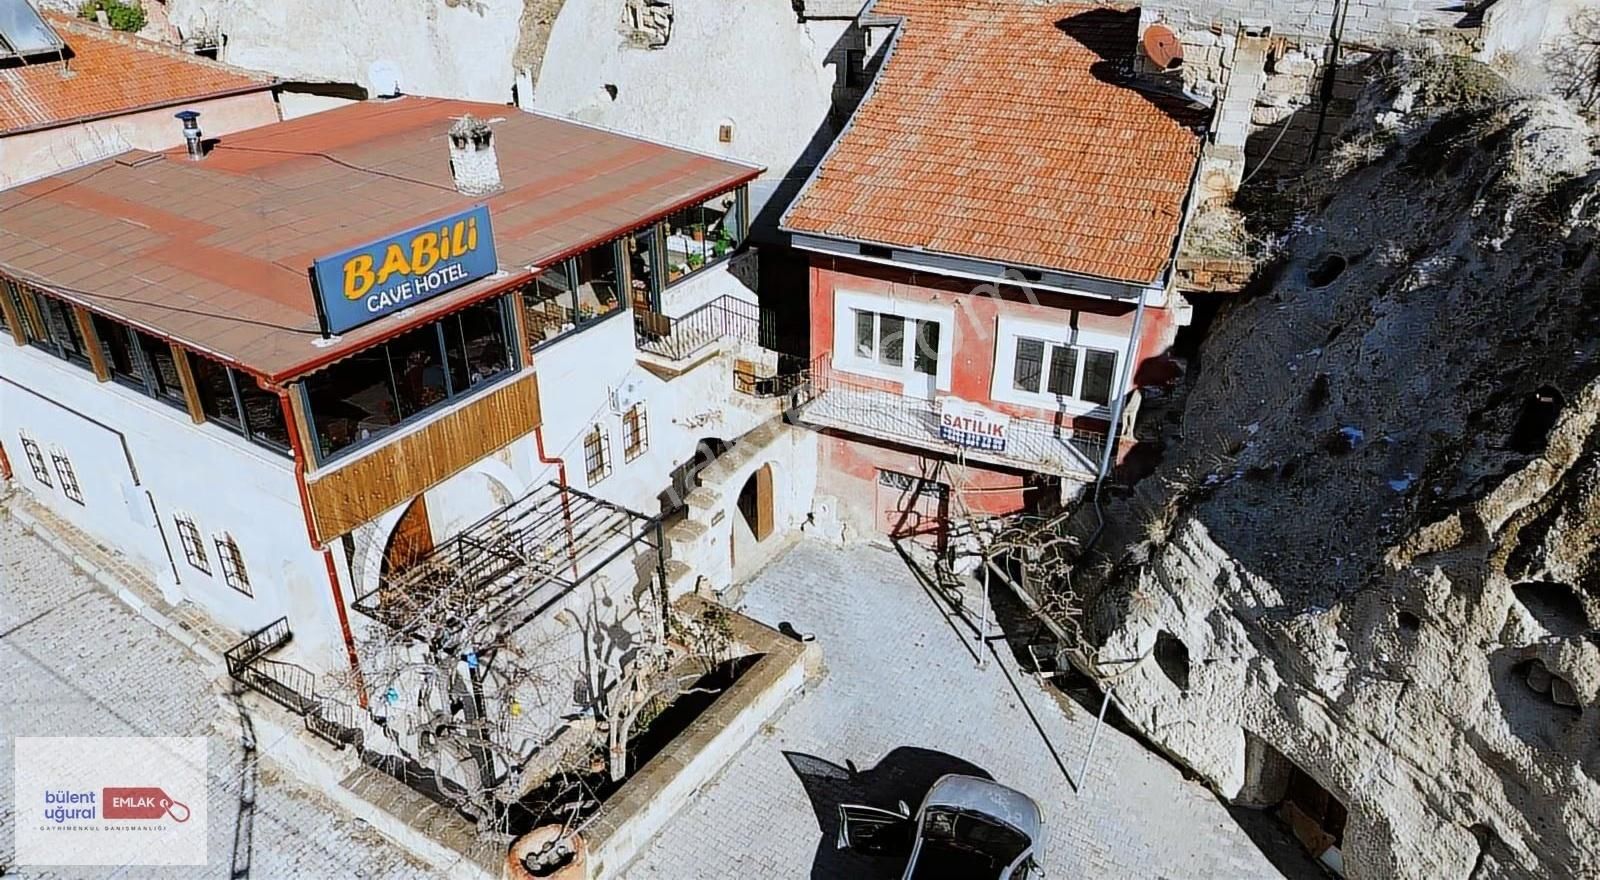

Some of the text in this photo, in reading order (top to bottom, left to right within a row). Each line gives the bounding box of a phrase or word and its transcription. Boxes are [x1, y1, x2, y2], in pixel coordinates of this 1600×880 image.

[367, 263, 468, 312] CAVE HOTEL
[943, 413, 1004, 437] SATILIK
